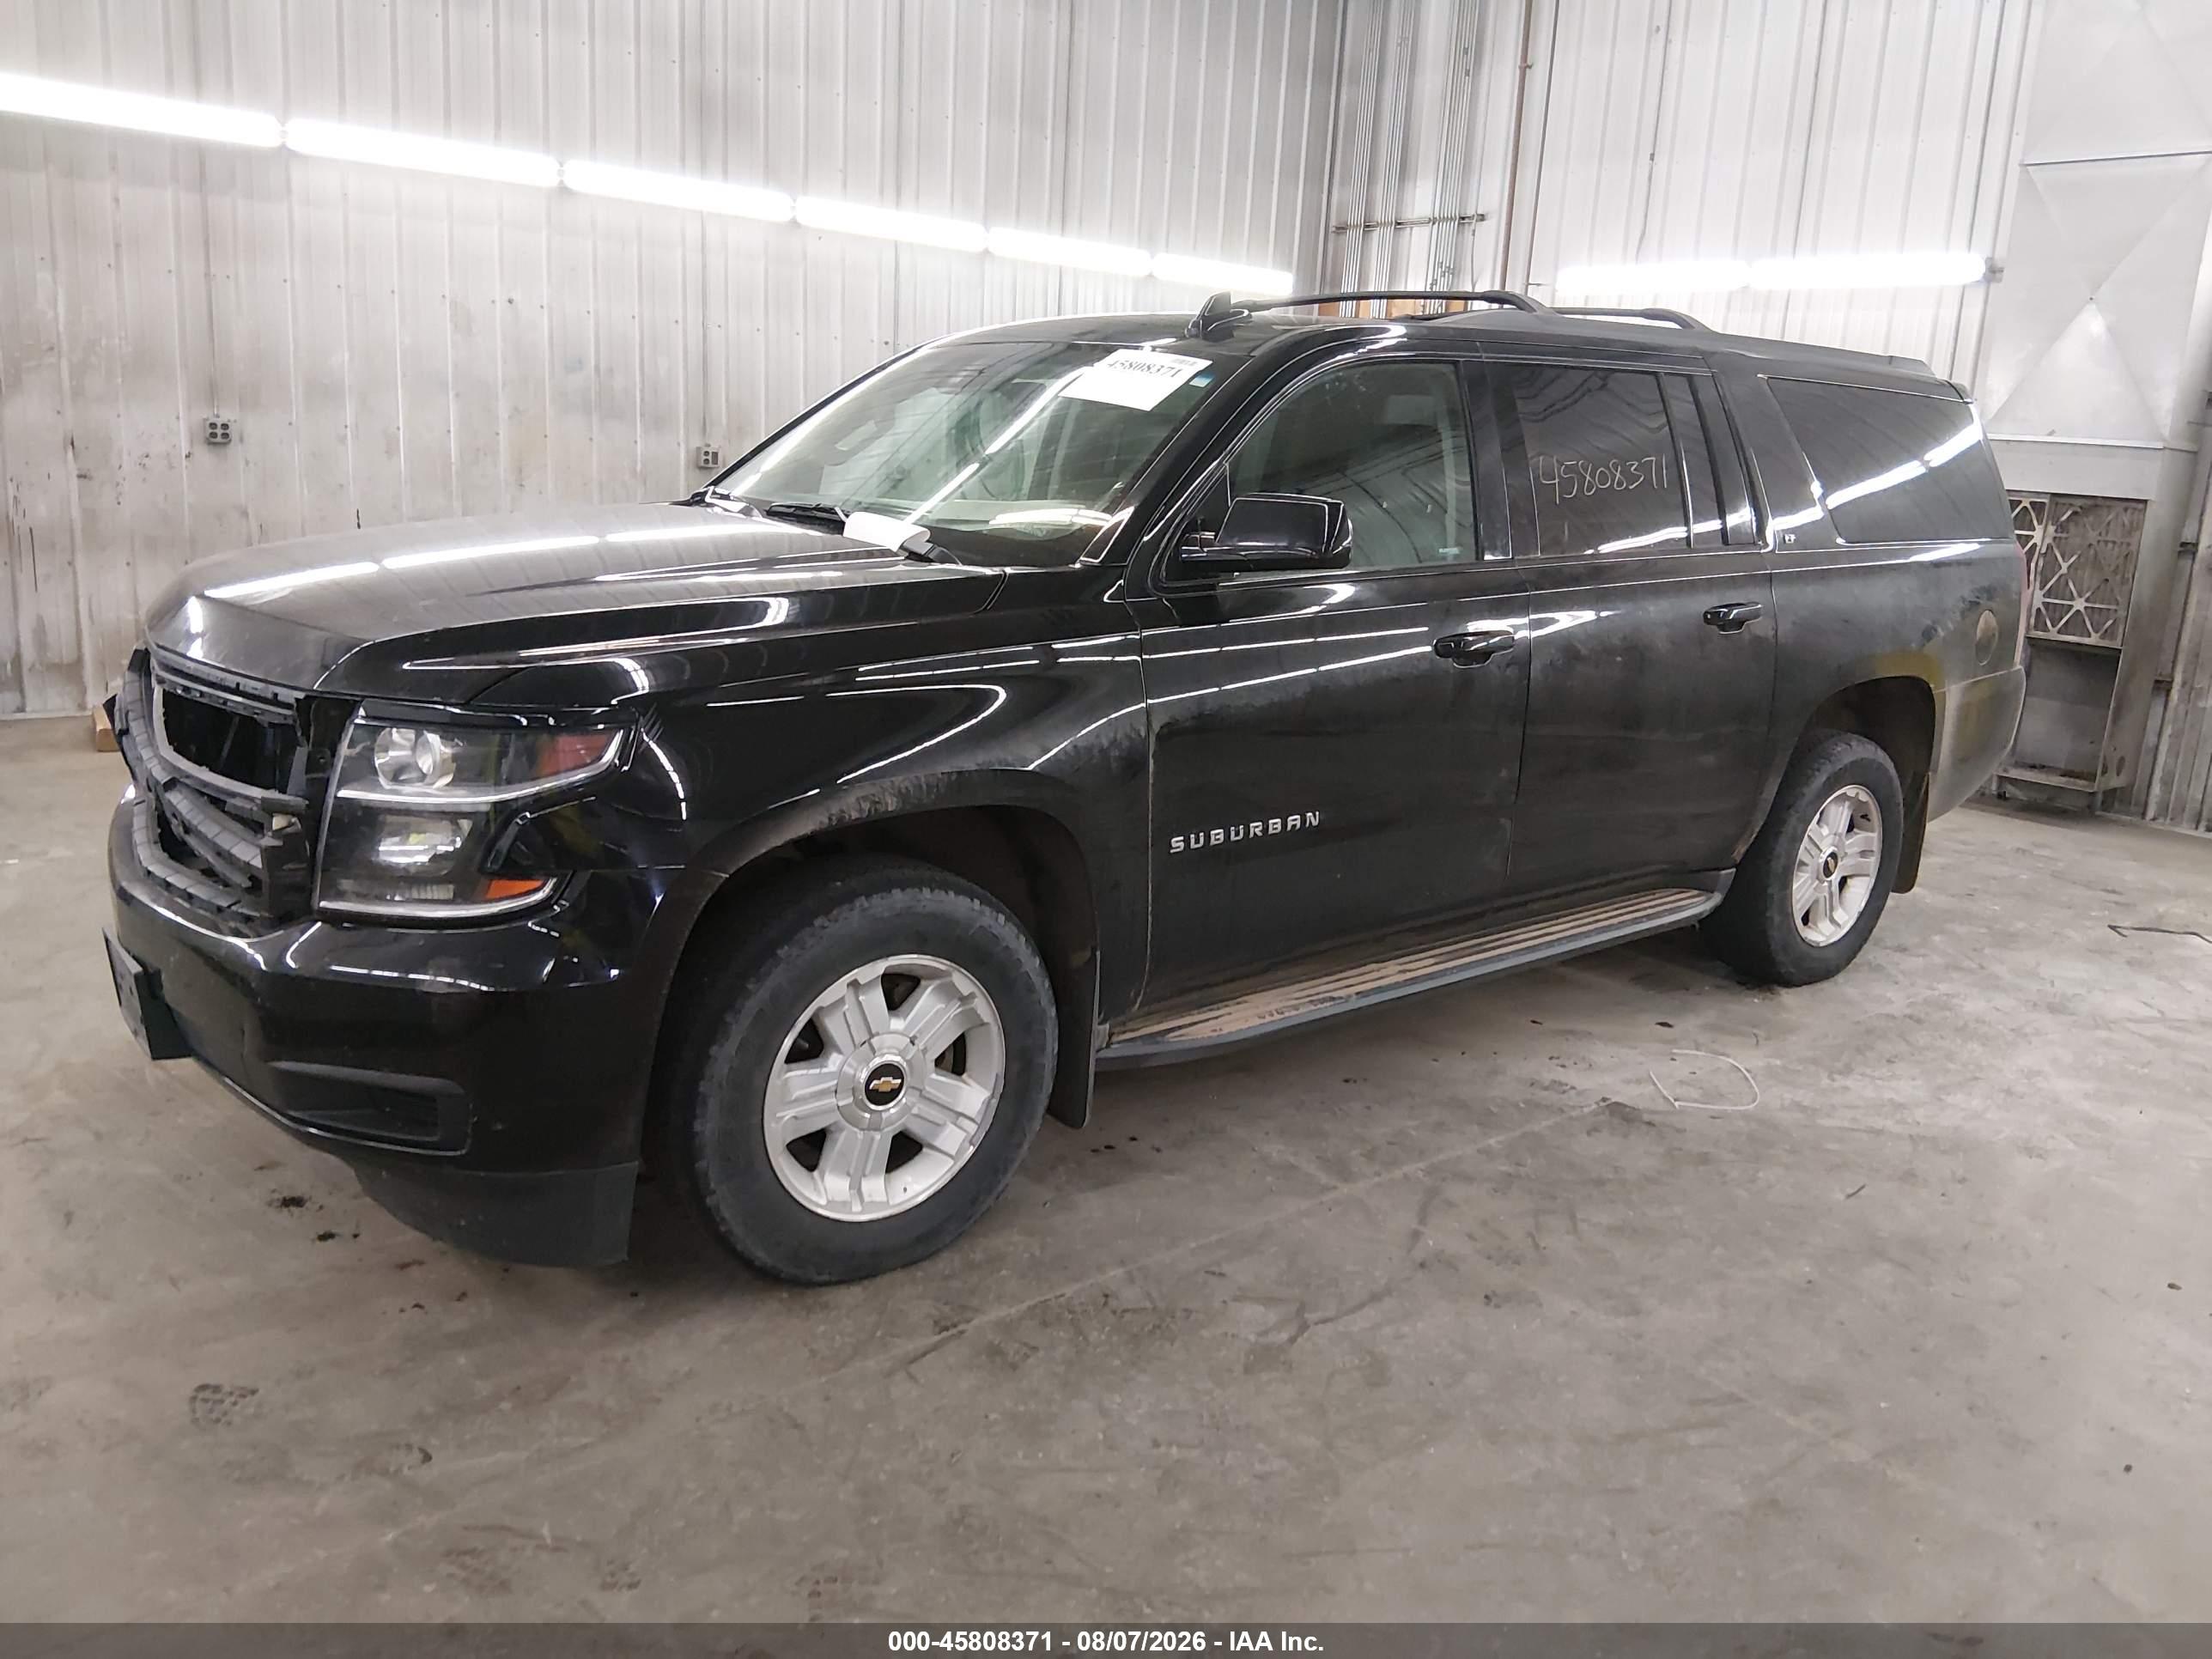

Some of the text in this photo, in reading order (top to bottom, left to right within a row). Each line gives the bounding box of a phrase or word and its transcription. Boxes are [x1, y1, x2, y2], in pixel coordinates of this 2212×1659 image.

[1106, 359, 1183, 378] 45808371
[1540, 453, 1668, 505] 45808371
[1170, 811, 1320, 854] SUBURBAN
